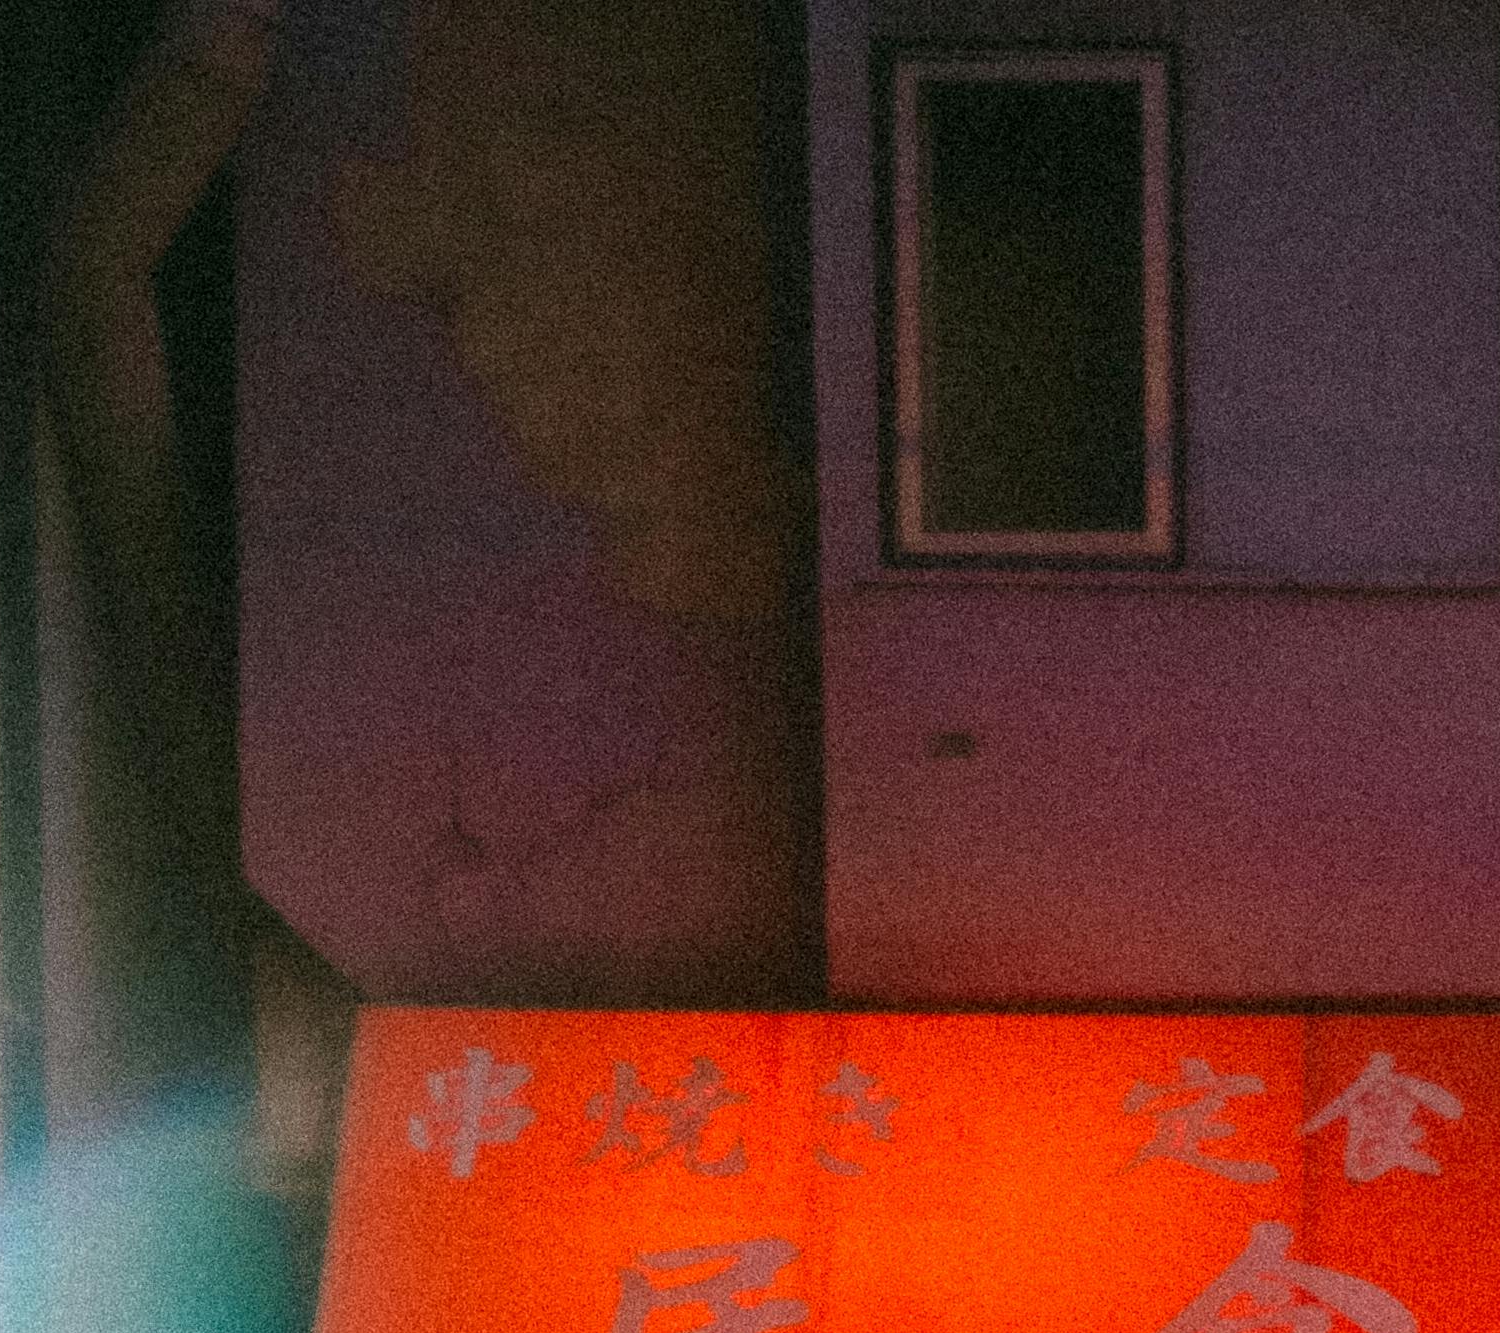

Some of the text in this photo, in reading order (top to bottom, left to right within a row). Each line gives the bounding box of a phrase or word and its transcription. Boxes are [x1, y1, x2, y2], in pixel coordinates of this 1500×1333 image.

[406, 1046, 1465, 1185] 串焼き 定食
